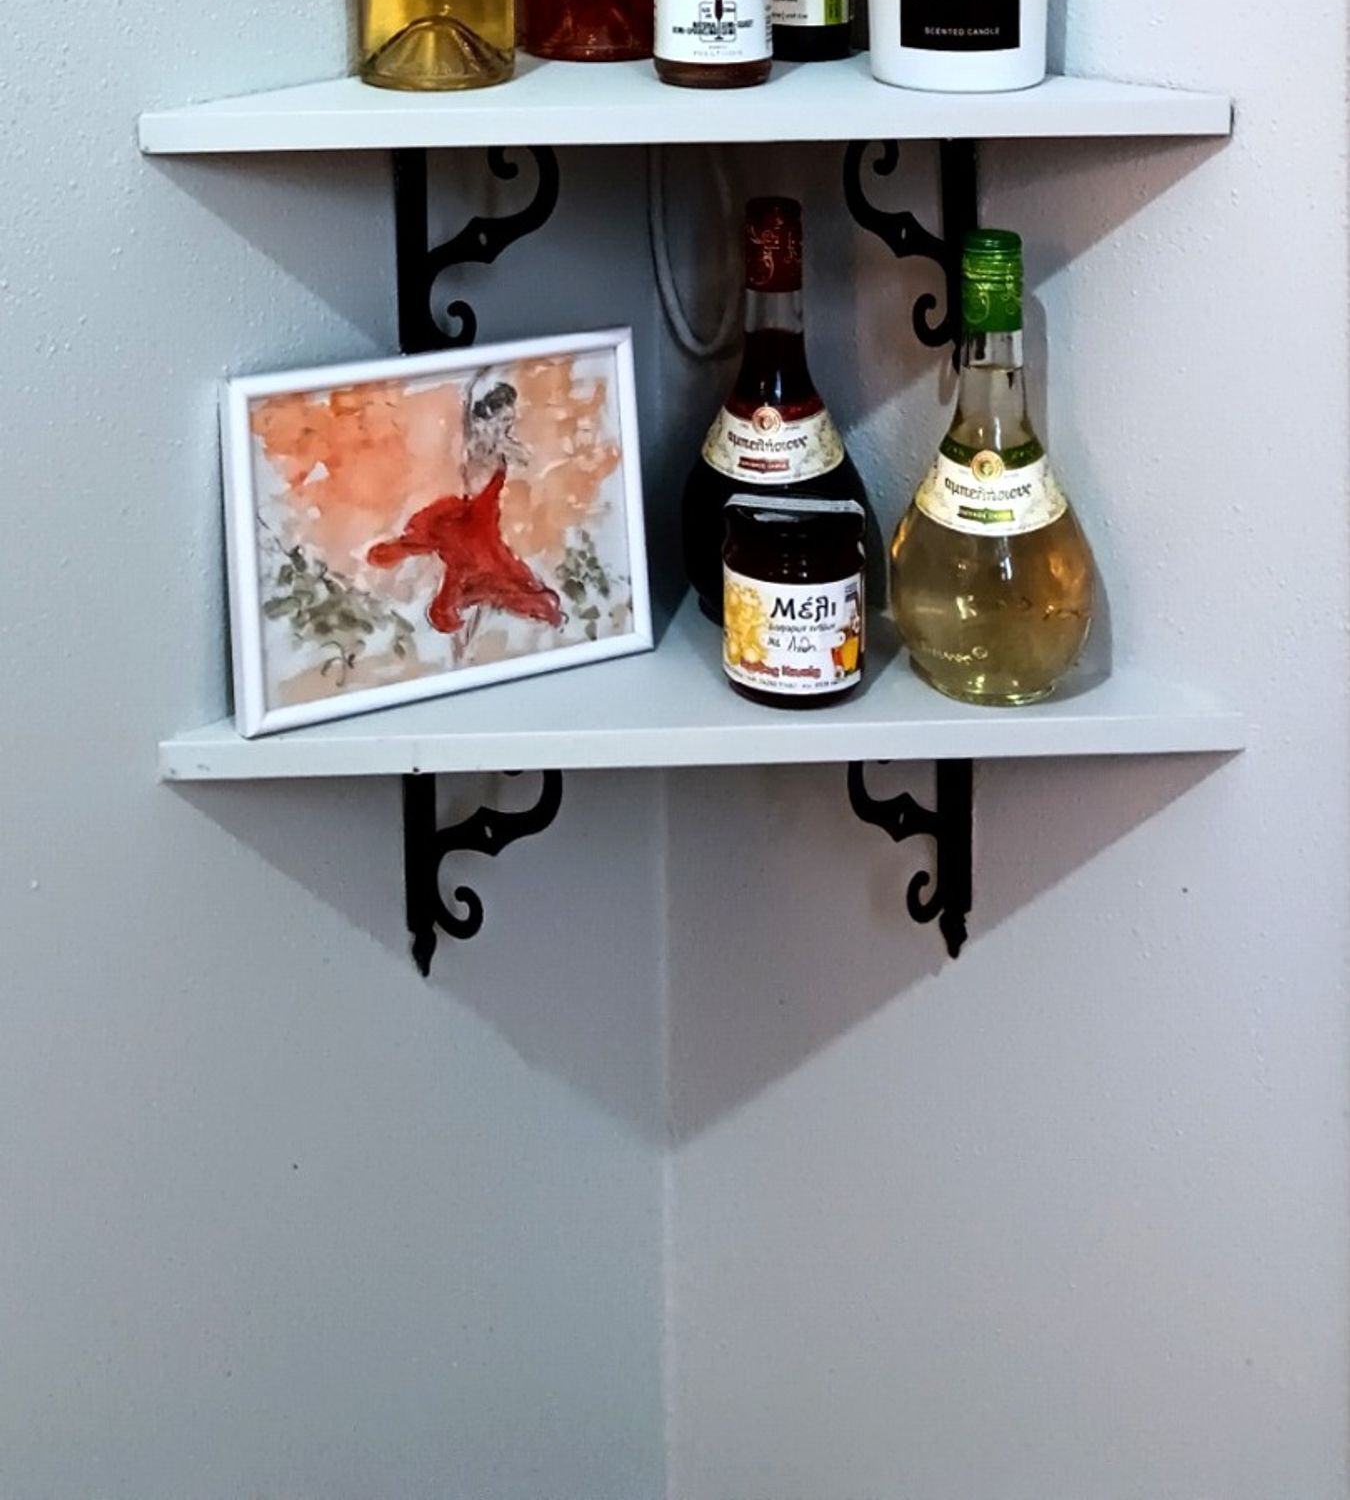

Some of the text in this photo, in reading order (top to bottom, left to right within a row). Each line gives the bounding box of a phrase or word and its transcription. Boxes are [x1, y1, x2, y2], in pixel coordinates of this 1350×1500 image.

[924, 26, 1000, 37] SCENTED CANDLE
[770, 595, 837, 622] Μέλι
